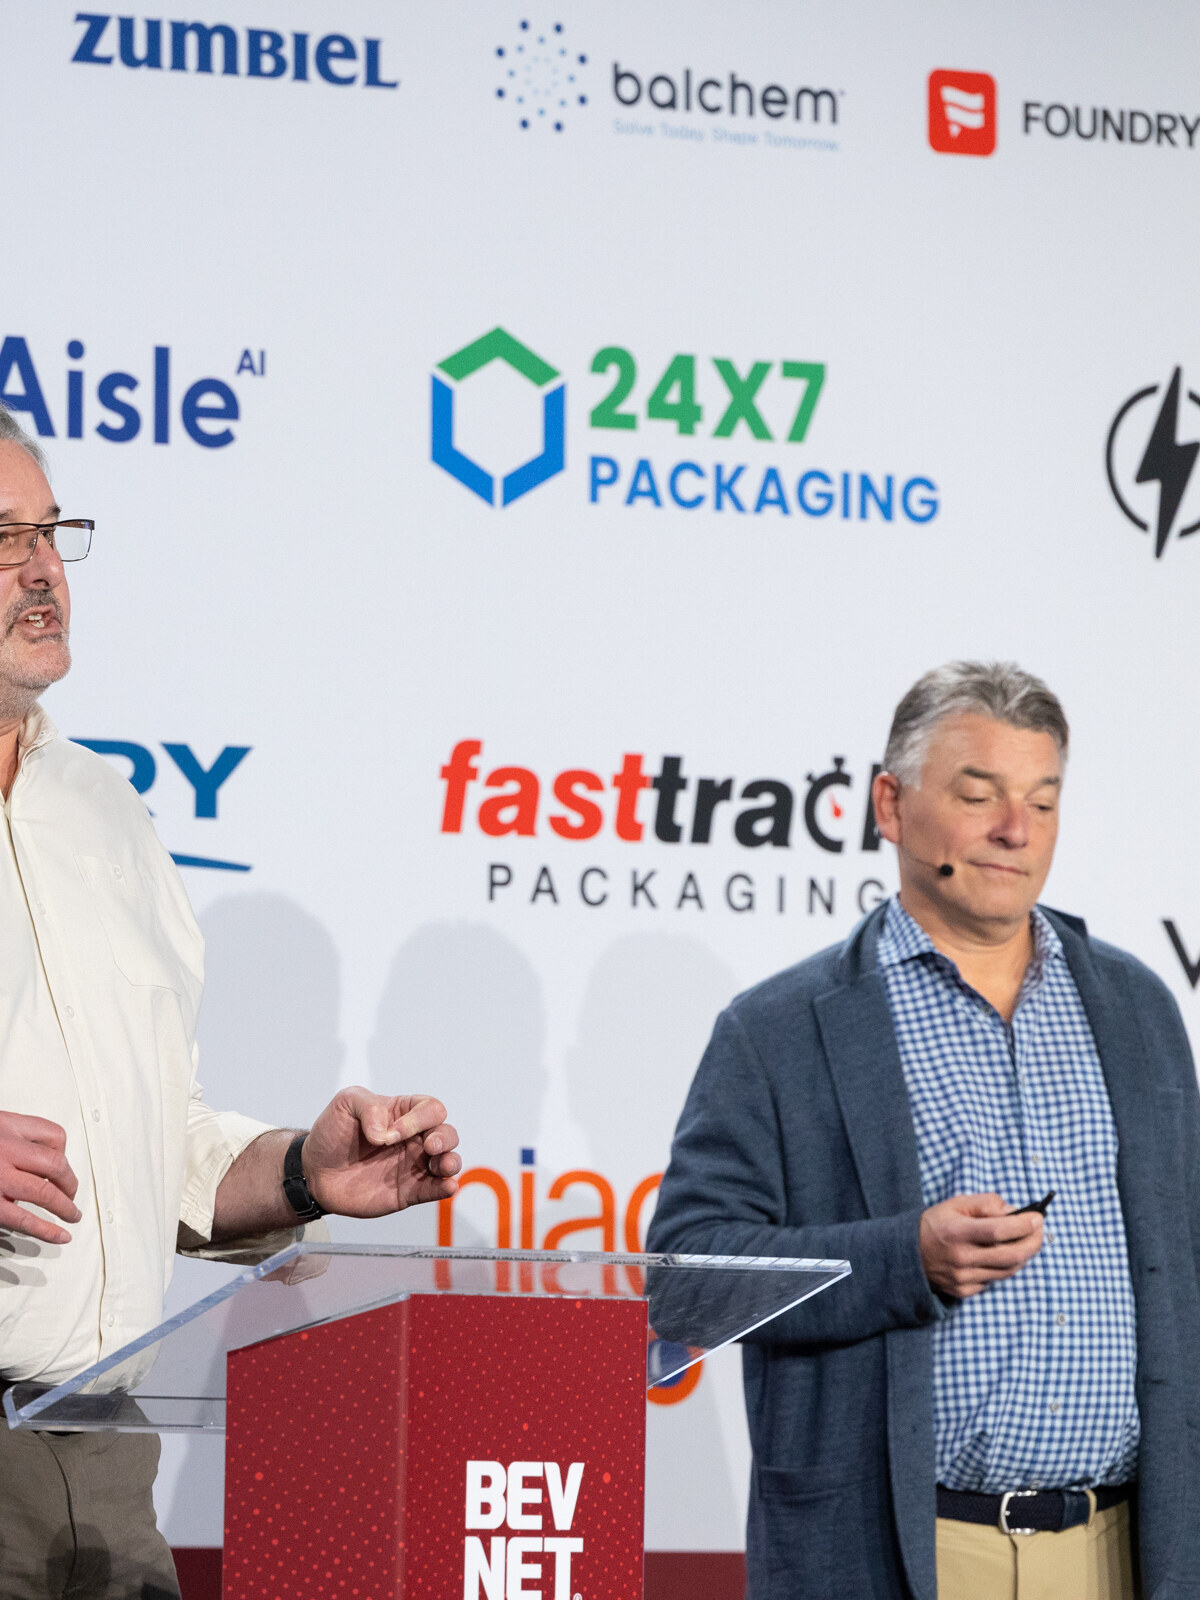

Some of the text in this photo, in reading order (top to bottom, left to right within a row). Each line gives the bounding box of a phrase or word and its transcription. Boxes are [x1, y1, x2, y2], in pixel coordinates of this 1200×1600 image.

[613, 62, 838, 124] balchem
[1023, 101, 1200, 149] FOUNDRY
[237, 349, 266, 377] AI
[590, 346, 826, 443] 24X7
[589, 455, 939, 524] PACKAGING
[488, 863, 887, 915] PACKAGING
[465, 1461, 585, 1530] BEV
